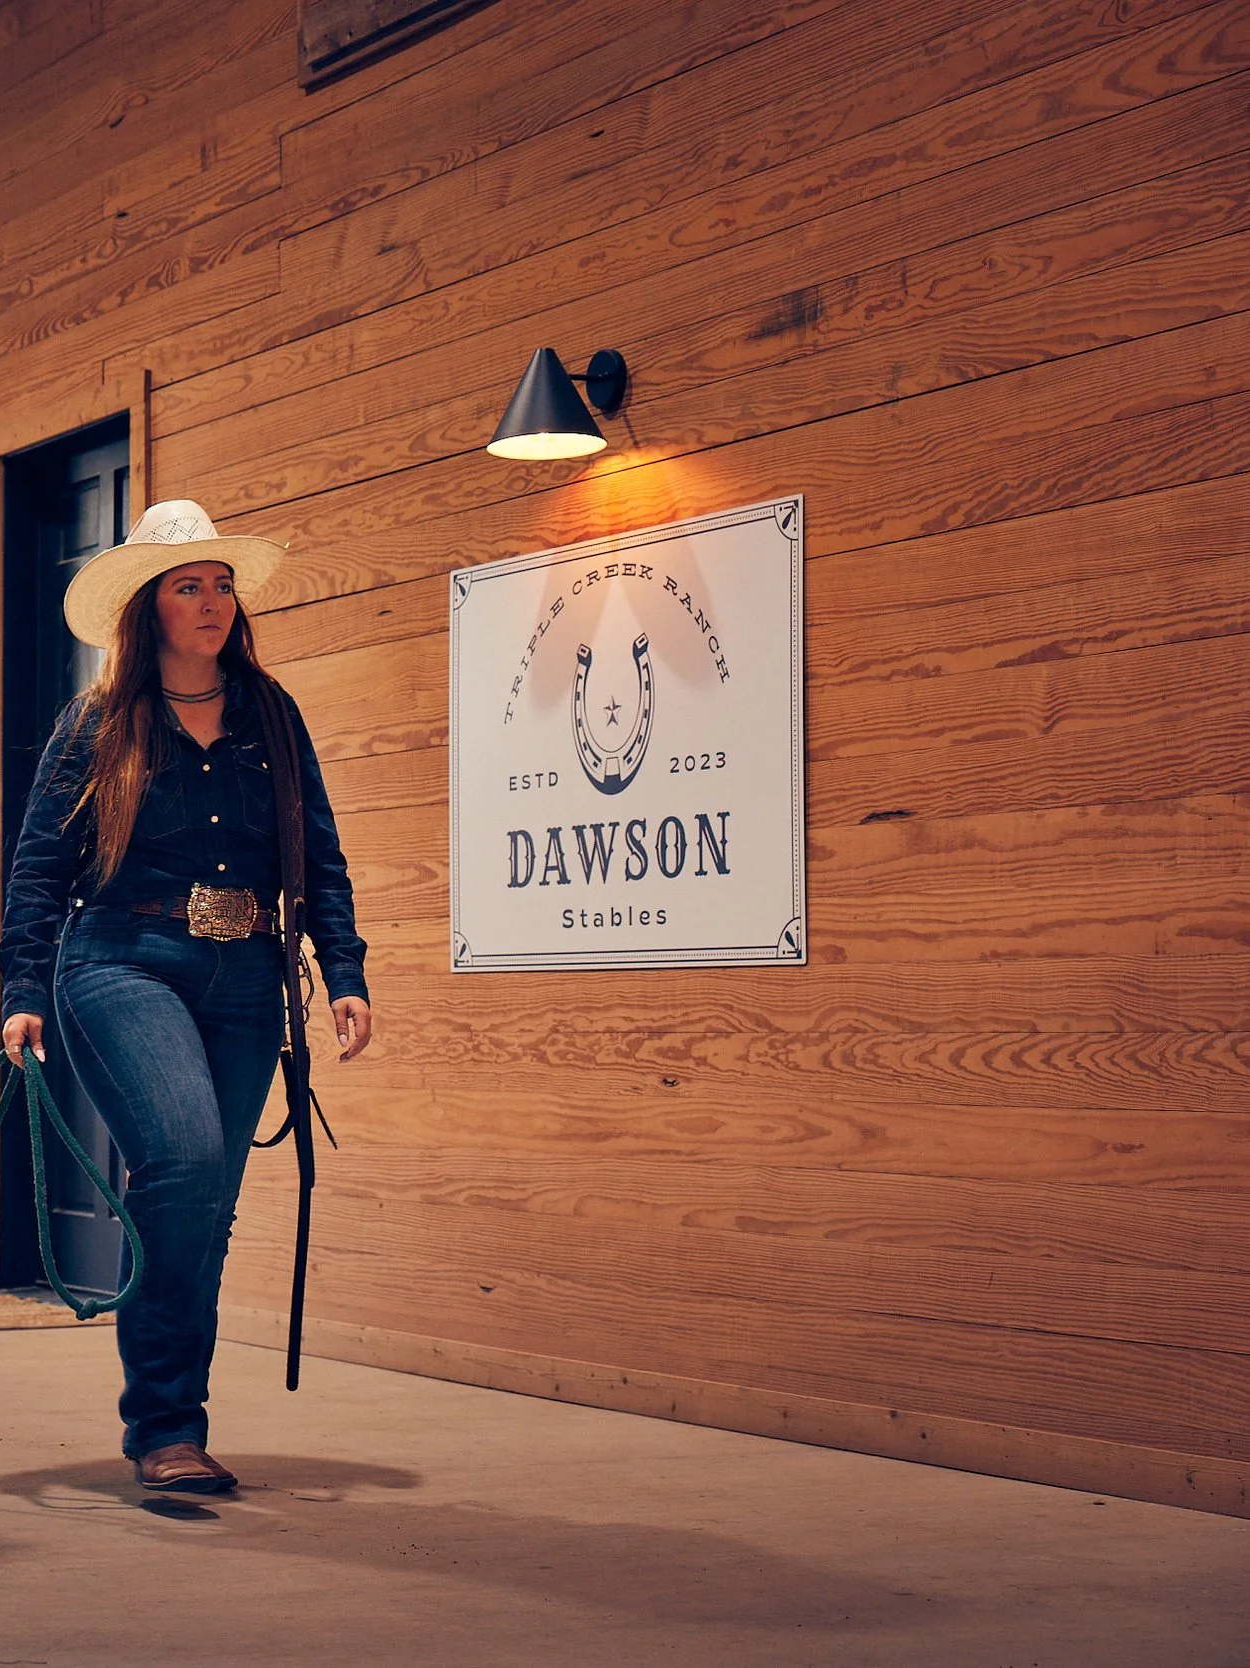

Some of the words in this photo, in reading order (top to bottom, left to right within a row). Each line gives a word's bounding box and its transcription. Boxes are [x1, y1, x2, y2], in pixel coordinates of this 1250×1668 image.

[503, 596, 566, 725] TRIPLE
[571, 562, 654, 596] CREEK
[663, 574, 731, 684] RANCH
[508, 771, 559, 792] ESTD
[669, 751, 727, 774] 2023
[506, 811, 731, 889] DAWSON
[562, 906, 668, 929] Stables
